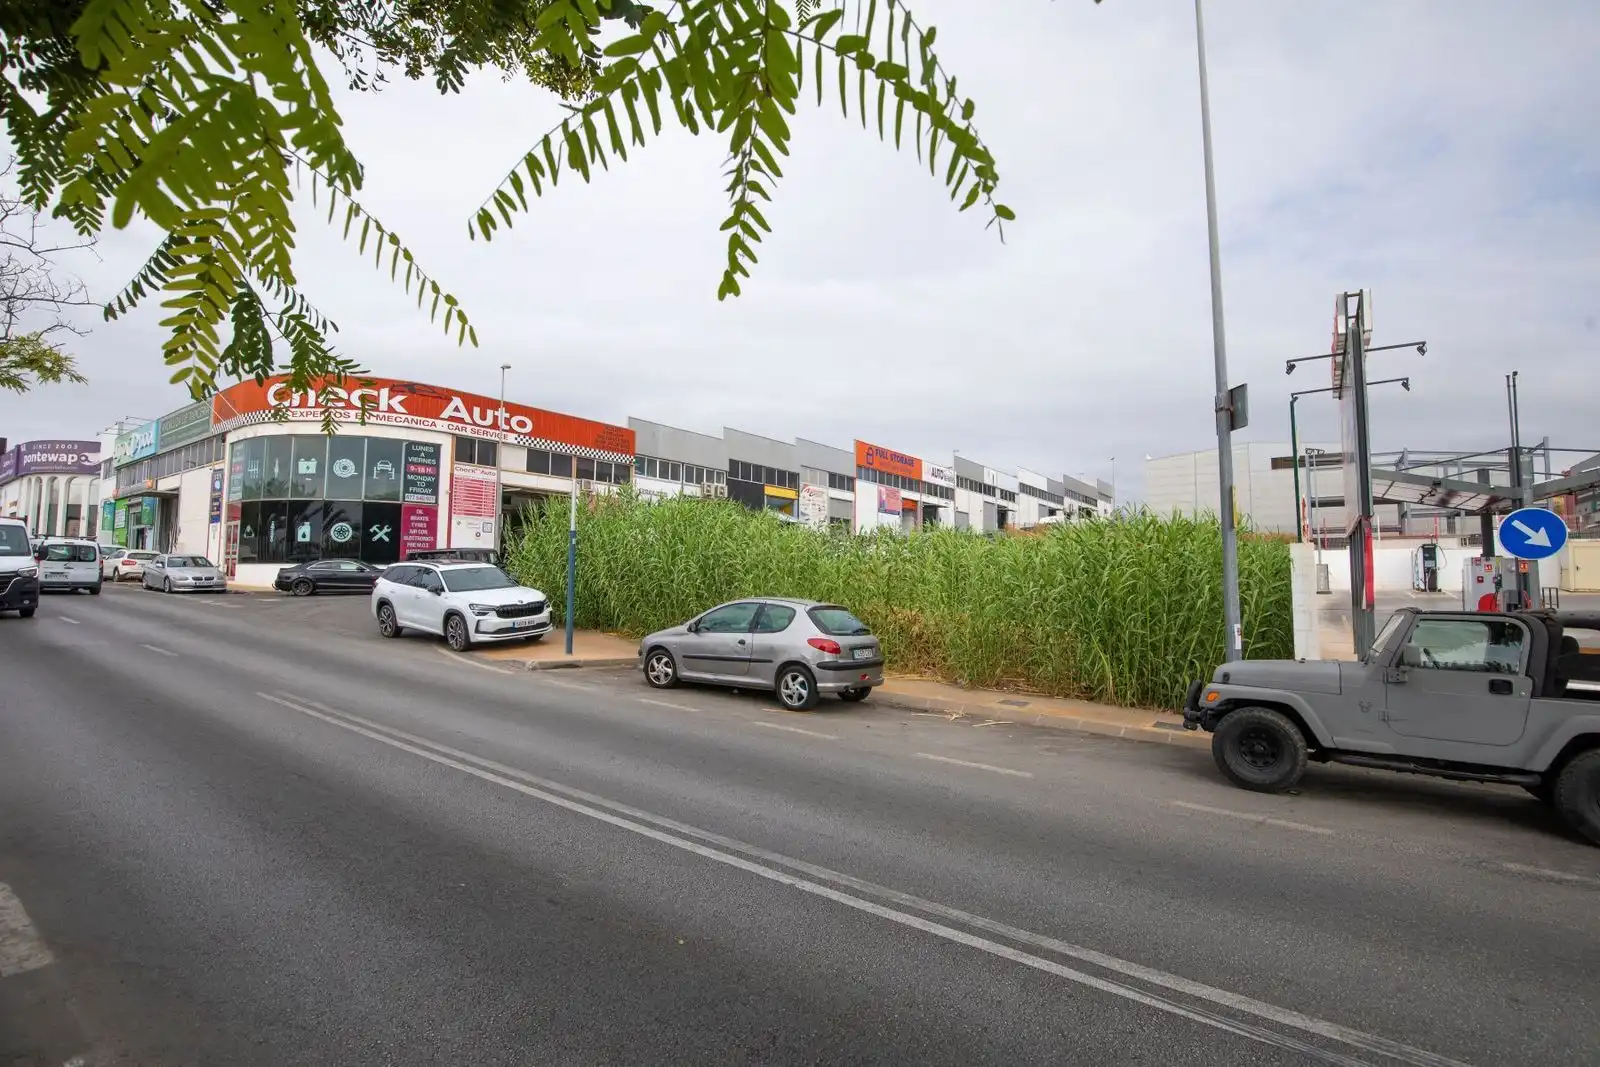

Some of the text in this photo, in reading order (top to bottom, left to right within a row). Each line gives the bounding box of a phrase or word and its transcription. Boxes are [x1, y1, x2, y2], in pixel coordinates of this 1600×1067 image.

[266, 382, 533, 434] Check Auto
[375, 414, 437, 428] MECANICA
[447, 424, 467, 433] CAR
[470, 428, 509, 441] SERVICE
[411, 444, 434, 453] LUNES
[23, 451, 78, 466] pontewap
[408, 456, 437, 465] VIERNES
[875, 448, 915, 467] FULL STORAGE
[455, 466, 476, 474] Check
[931, 467, 944, 480] AUTO
[407, 474, 436, 482] MONDAY
[409, 486, 433, 494] FRIDAY
